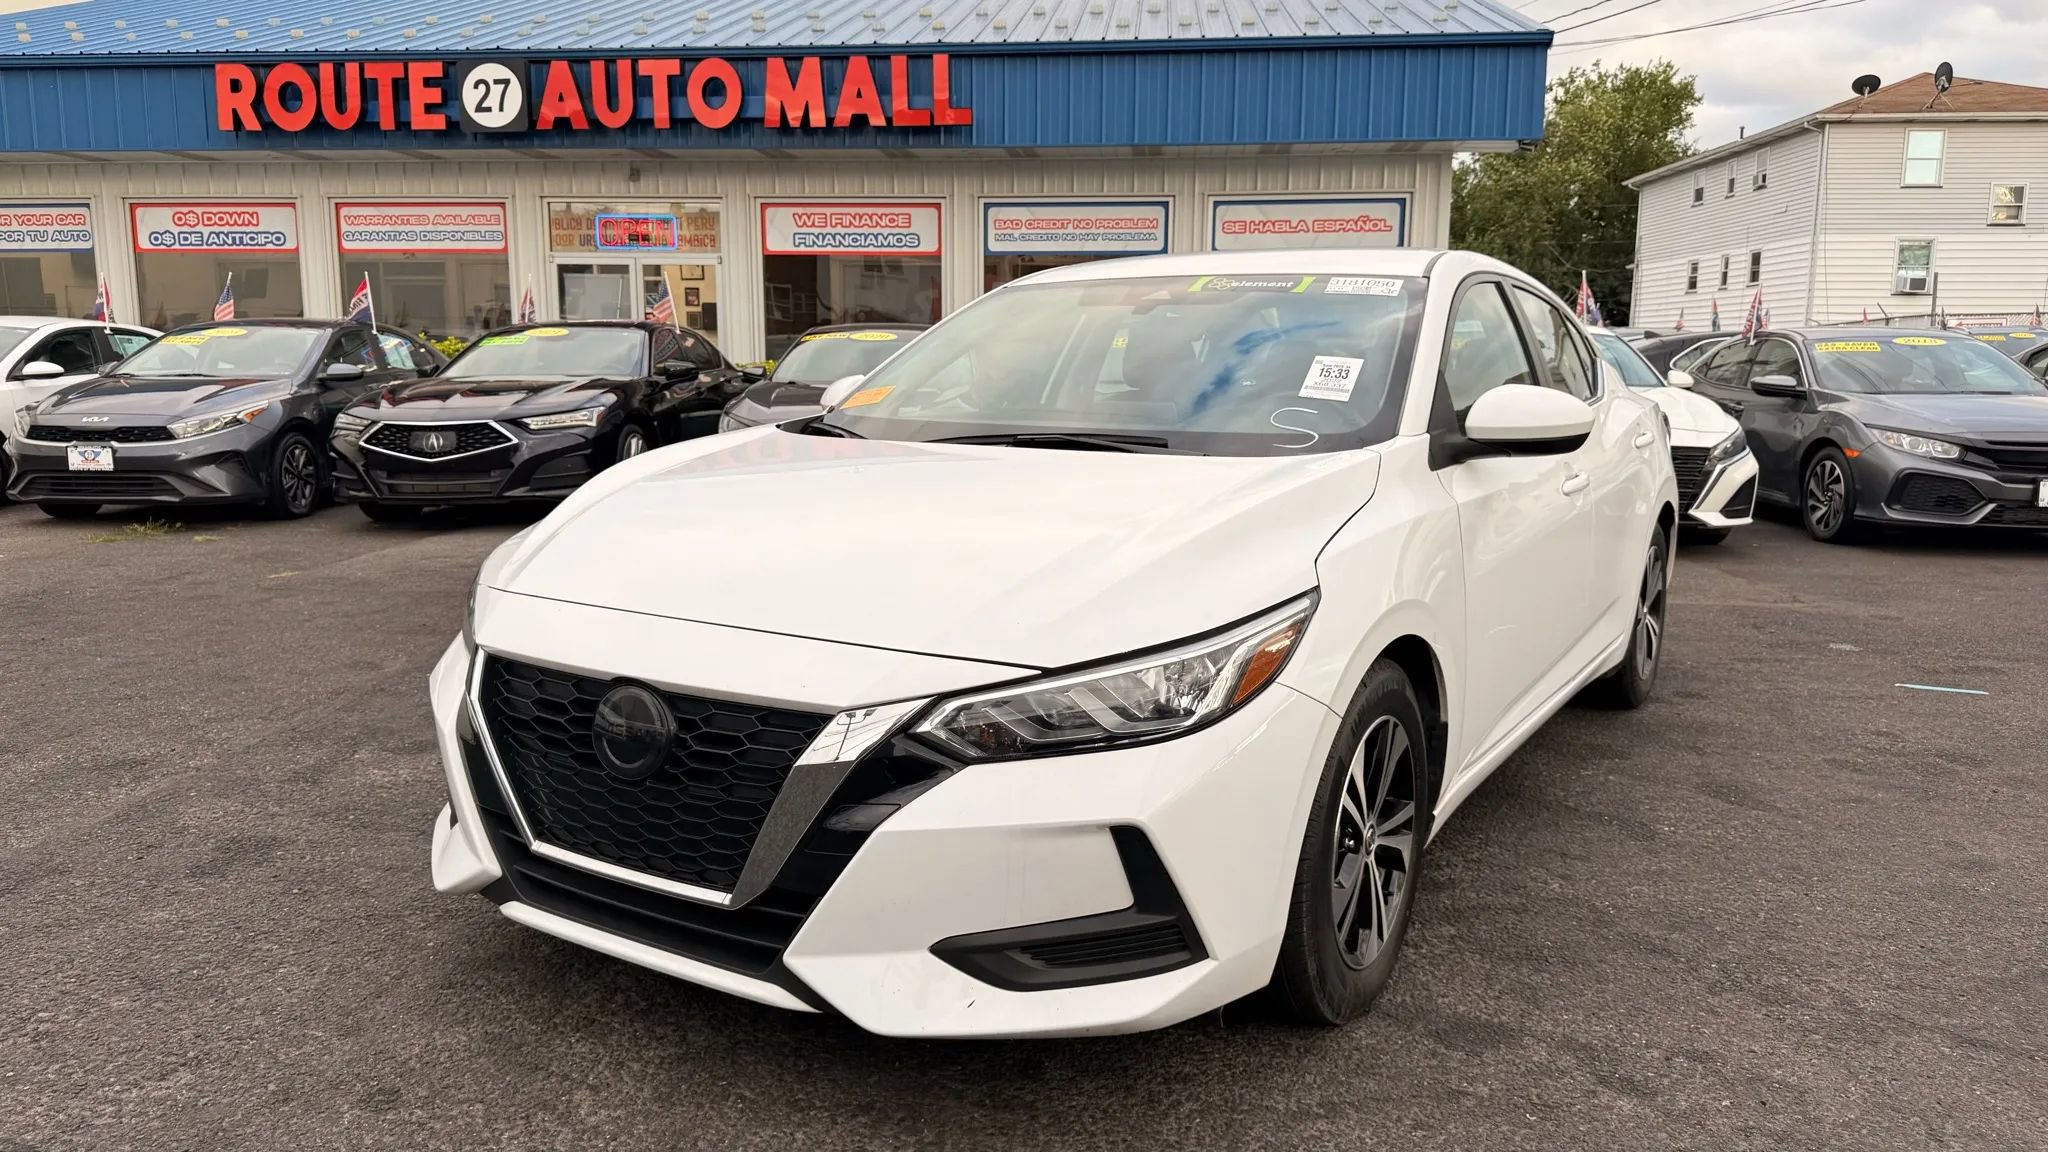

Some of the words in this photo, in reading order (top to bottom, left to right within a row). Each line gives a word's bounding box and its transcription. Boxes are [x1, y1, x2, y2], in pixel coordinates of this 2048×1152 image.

[215, 61, 447, 132] ROUTE
[473, 78, 511, 113] 27
[536, 57, 742, 130] AUTO
[764, 53, 972, 128] MALL
[14, 214, 53, 226] YOUR
[56, 214, 86, 226] CAR
[202, 211, 259, 226] DOWN
[344, 214, 429, 226] WARRANTIES
[432, 214, 500, 225] AVAILABLE
[793, 213, 827, 228] WE
[830, 213, 911, 228] FINANCE
[994, 219, 1023, 230] BAD
[1025, 218, 1071, 230] CREDIT
[1072, 218, 1093, 229] NO
[1095, 217, 1158, 229] PROBLEM
[1222, 220, 1247, 234] SE
[1249, 219, 1309, 233] HABLA
[1312, 215, 1392, 232] ESPAÑOL
[27, 230, 48, 242] TU
[51, 230, 91, 242] AUTO
[178, 231, 203, 246] DE
[206, 231, 286, 246] ANTICIPO
[343, 230, 417, 242] GARANTIAS
[419, 230, 503, 242] DISPONIBLES
[599, 217, 675, 247] OPEN
[995, 233, 1018, 242] MAL
[1061, 233, 1078, 241] NO
[1079, 233, 1101, 241] HAY
[1101, 232, 1157, 241] PROBLEMA
[793, 232, 920, 248] FINANCIAMOS
[1231, 280, 1294, 288] element
[1319, 367, 1350, 380] 15:33
[1270, 407, 1319, 448] S
